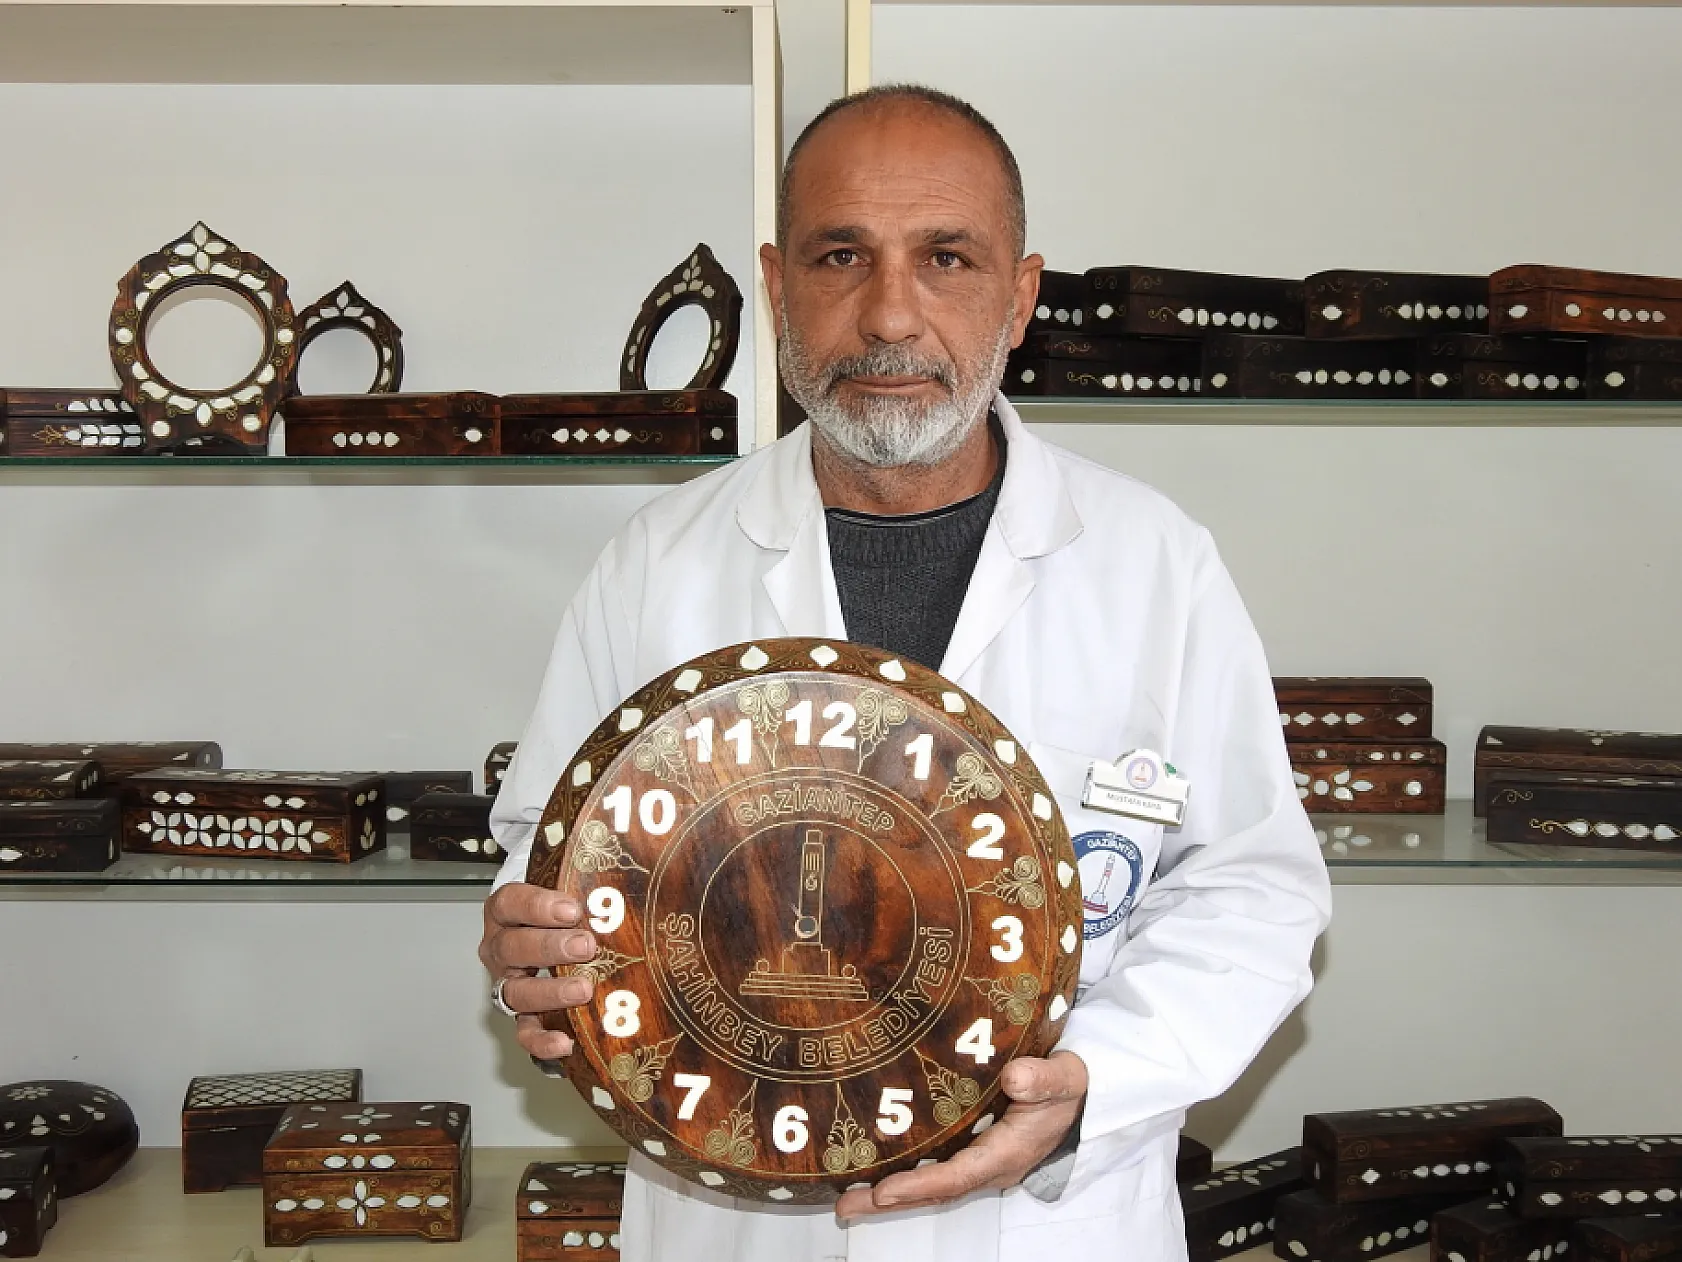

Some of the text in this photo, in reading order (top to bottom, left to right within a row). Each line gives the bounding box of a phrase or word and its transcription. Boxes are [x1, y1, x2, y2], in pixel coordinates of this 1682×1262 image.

[685, 717, 752, 765] 11
[785, 698, 857, 750] 12
[904, 733, 934, 781] 1
[603, 785, 676, 836] 10
[733, 781, 895, 832] GAZİANTEP
[967, 812, 1006, 860] 2
[586, 886, 625, 934] 9
[991, 915, 1024, 963] 3
[603, 989, 640, 1037] 8
[658, 912, 954, 1068] ŞAHİNBEY BELEDİYESİ
[954, 1018, 995, 1064] 4
[674, 1073, 711, 1119] 7
[877, 1088, 914, 1136] 5
[772, 1105, 809, 1153] 6
